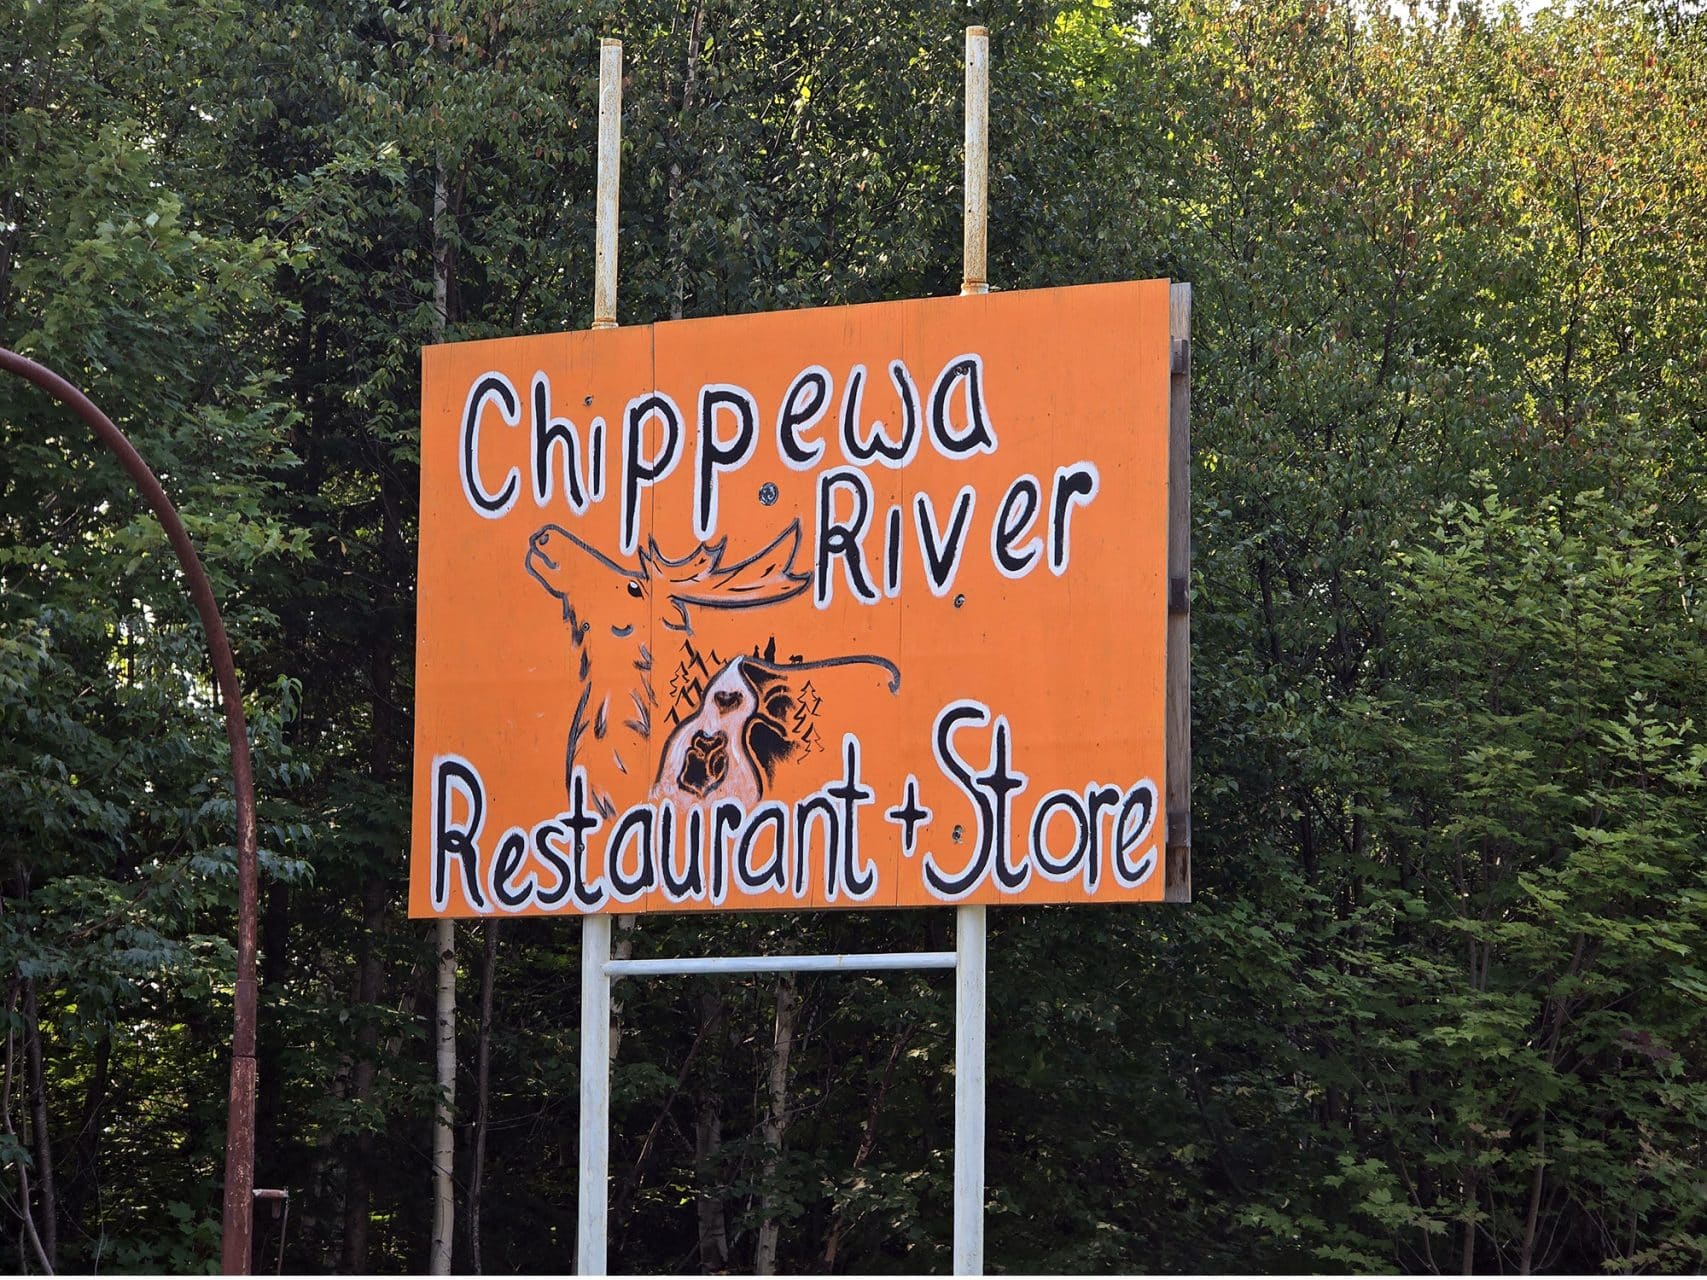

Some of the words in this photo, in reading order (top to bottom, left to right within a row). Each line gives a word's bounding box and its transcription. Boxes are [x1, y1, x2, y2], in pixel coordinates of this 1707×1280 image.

[461, 354, 998, 555] Chippewa
[813, 461, 1099, 609] River
[430, 733, 878, 913] Restaurant
[884, 773, 933, 858] +
[925, 699, 1158, 901] Store
